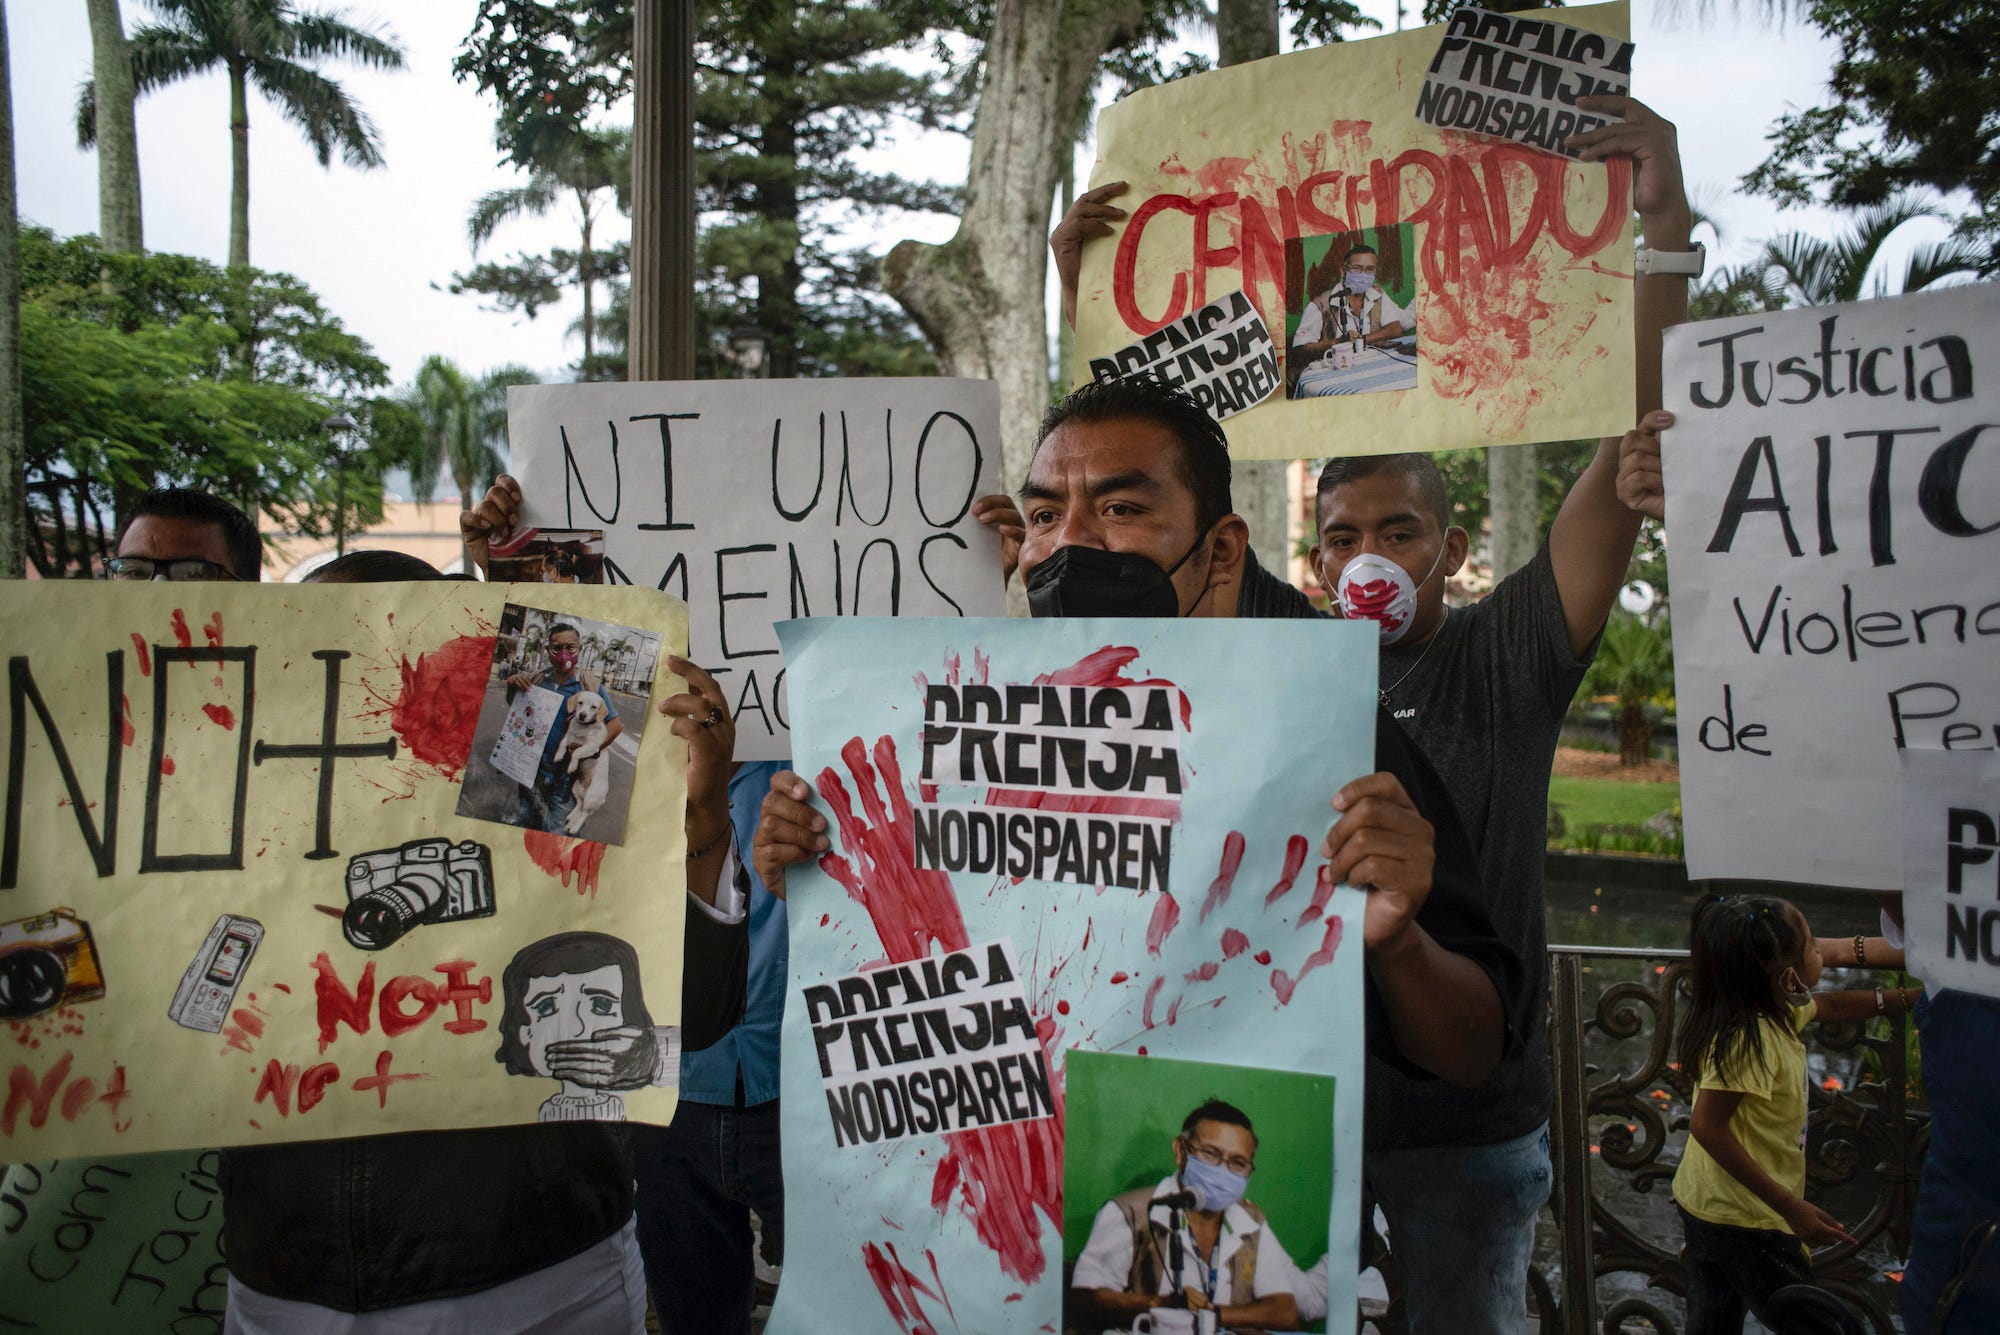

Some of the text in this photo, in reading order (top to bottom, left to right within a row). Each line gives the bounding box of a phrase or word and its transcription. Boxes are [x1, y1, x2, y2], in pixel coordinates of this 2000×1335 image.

[1415, 80, 1614, 161] NODISPARE
[1690, 315, 1974, 409] Justicia
[560, 408, 983, 531] NI UNO
[603, 532, 968, 659] MENOS
[1699, 684, 1771, 756] de
[914, 808, 1172, 892] NODISPAREN
[825, 1050, 1055, 1148] NODISPAREN
